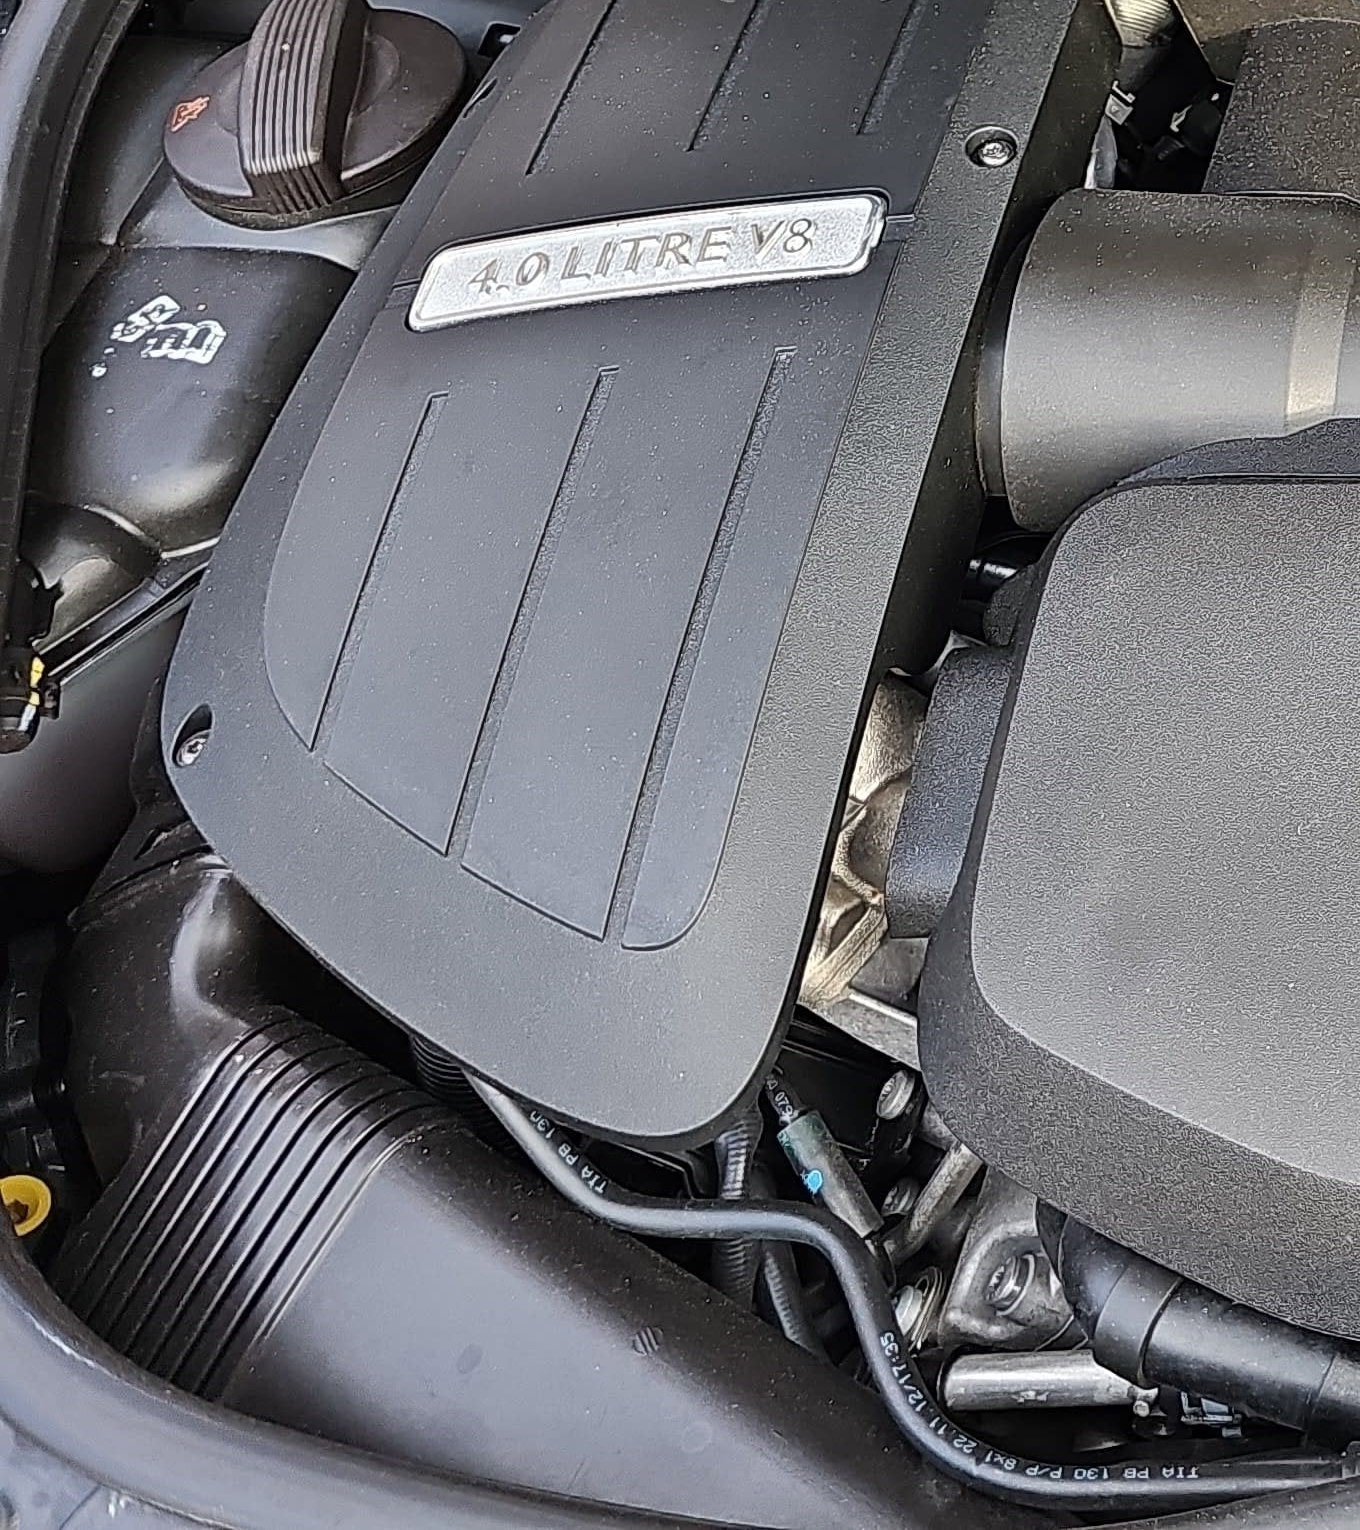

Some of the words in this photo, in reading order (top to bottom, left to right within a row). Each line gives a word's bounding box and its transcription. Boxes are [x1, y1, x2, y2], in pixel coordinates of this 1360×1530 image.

[560, 226, 732, 282] LITRE
[750, 217, 815, 256] V8
[558, 1143, 579, 1166] PB
[581, 1165, 607, 1194] TIA
[984, 1449, 1018, 1470] 8x1
[1025, 1465, 1063, 1479] P/P
[1073, 1466, 1109, 1480] 130
[1123, 1467, 1149, 1479] PB
